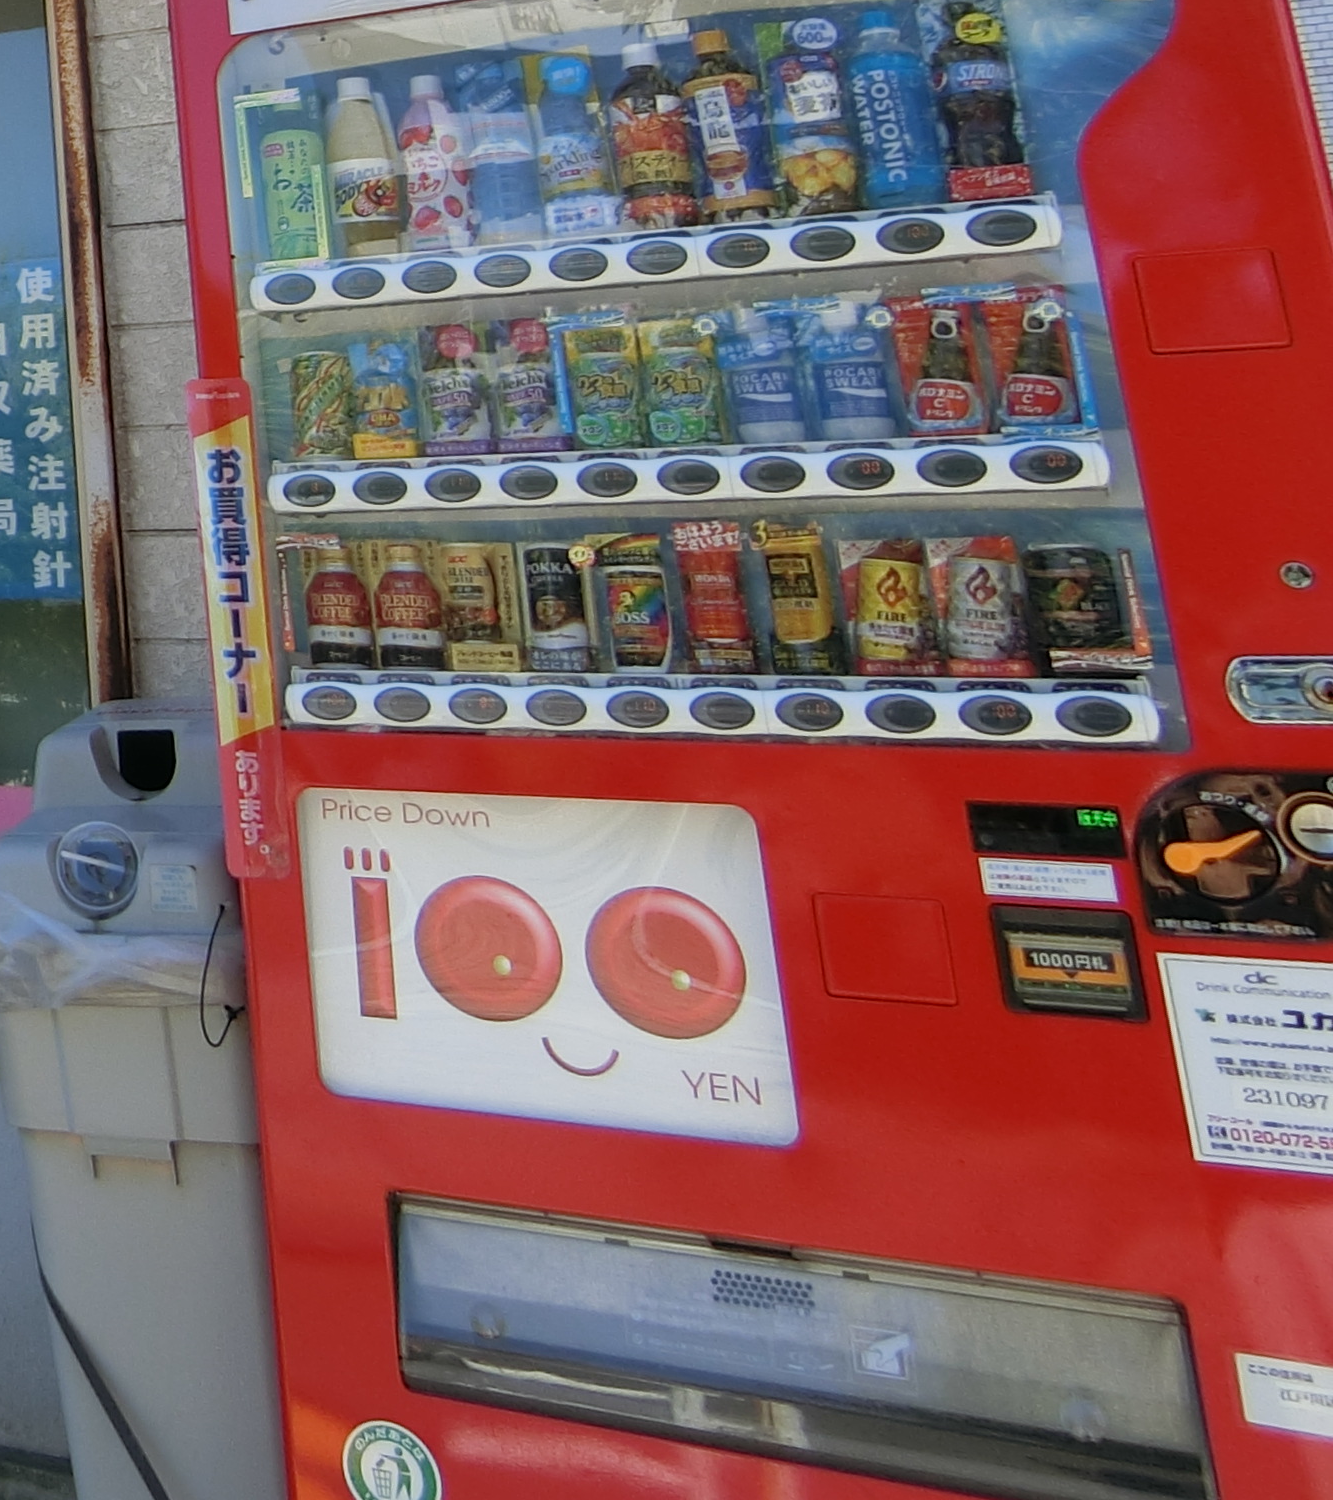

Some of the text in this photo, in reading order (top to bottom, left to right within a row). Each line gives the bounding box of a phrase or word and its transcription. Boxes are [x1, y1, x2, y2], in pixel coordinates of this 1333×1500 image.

[852, 73, 875, 146] WATER
[867, 69, 908, 183] POSTONIC
[16, 266, 73, 589] 使用済み注射針
[206, 447, 257, 717] お買得コーナー
[234, 750, 271, 855] あります。
[320, 798, 491, 829] Price Down
[345, 874, 747, 1040] 100
[1029, 951, 1109, 970] 1000円札
[680, 1069, 763, 1106] YEN
[1242, 1086, 1329, 1111] 231097
